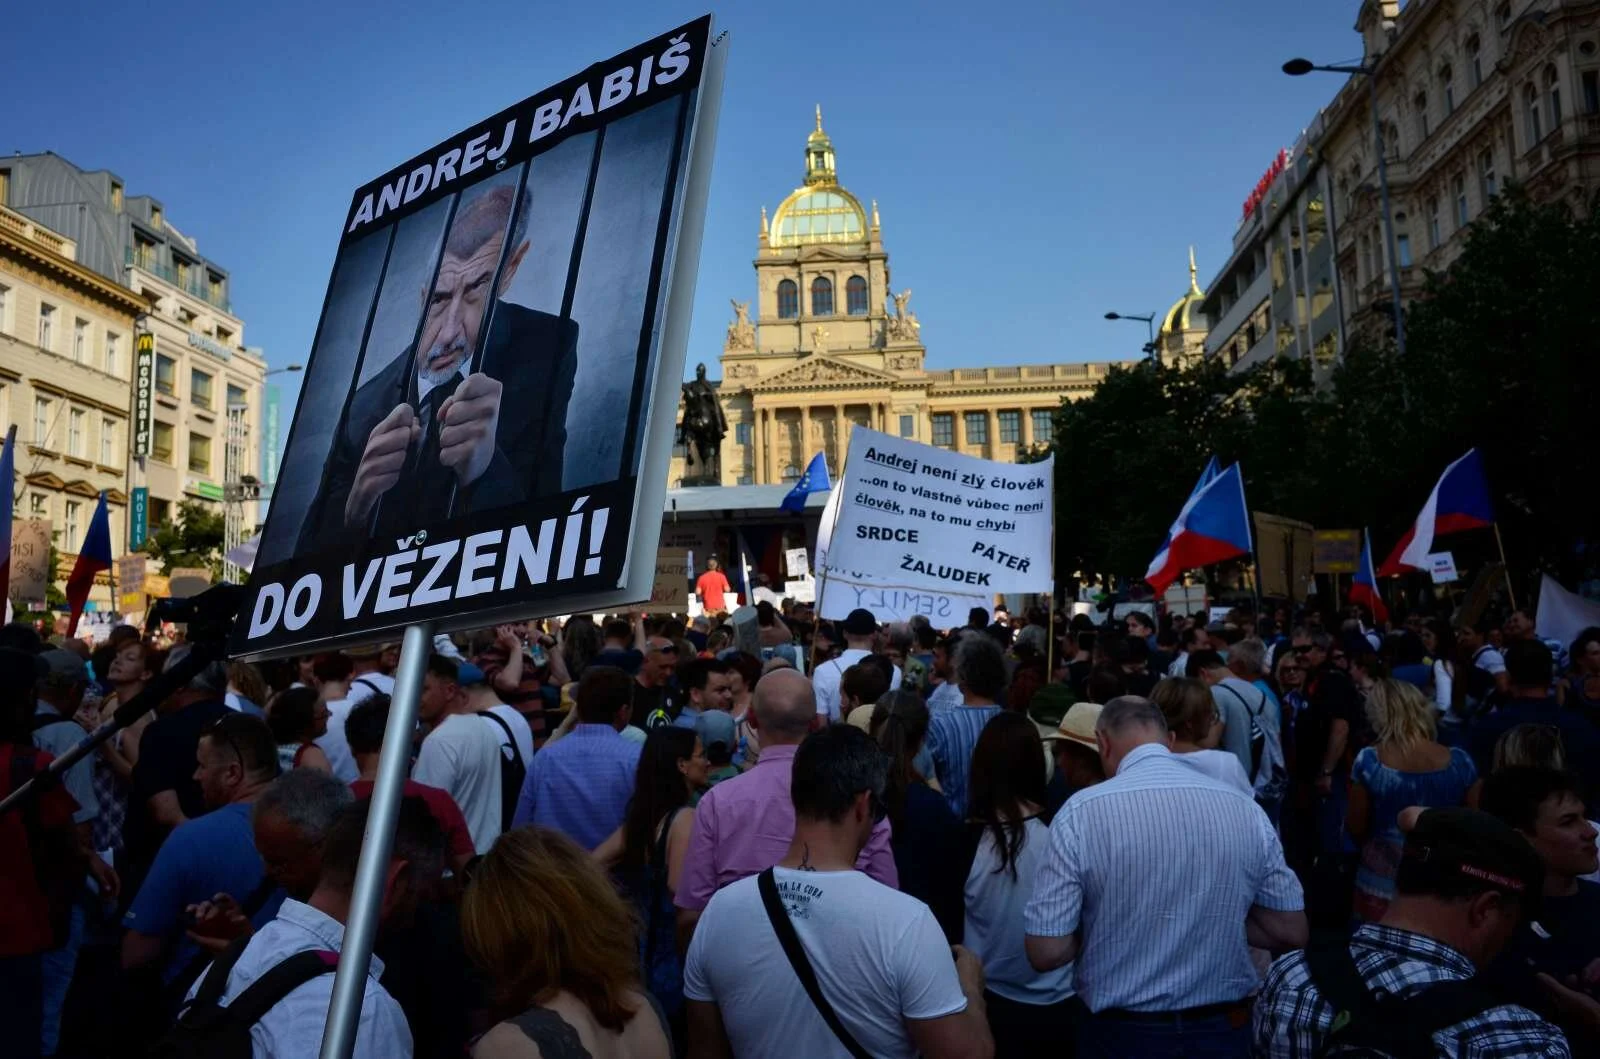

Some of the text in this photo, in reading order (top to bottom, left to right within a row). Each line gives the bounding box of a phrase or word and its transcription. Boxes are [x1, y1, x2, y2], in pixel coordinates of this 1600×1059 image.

[348, 33, 692, 233] ANDREJ BABIŠ
[863, 446, 1045, 491] Andrej není zlý člověk
[854, 491, 1017, 533] člověk, na to mu chybí
[892, 478, 907, 493] to
[911, 484, 962, 505] vlastně
[965, 497, 1010, 511] vůbec
[1013, 499, 1044, 513] není
[136, 493, 144, 544] HOTEL
[855, 524, 920, 543] SRDCE
[247, 495, 610, 640] DO VĚZENÍ!
[899, 552, 991, 586] ŽALUDEK
[970, 540, 1032, 573] PÁTEŘ
[791, 881, 801, 892] LA
[804, 884, 823, 898] CUBA
